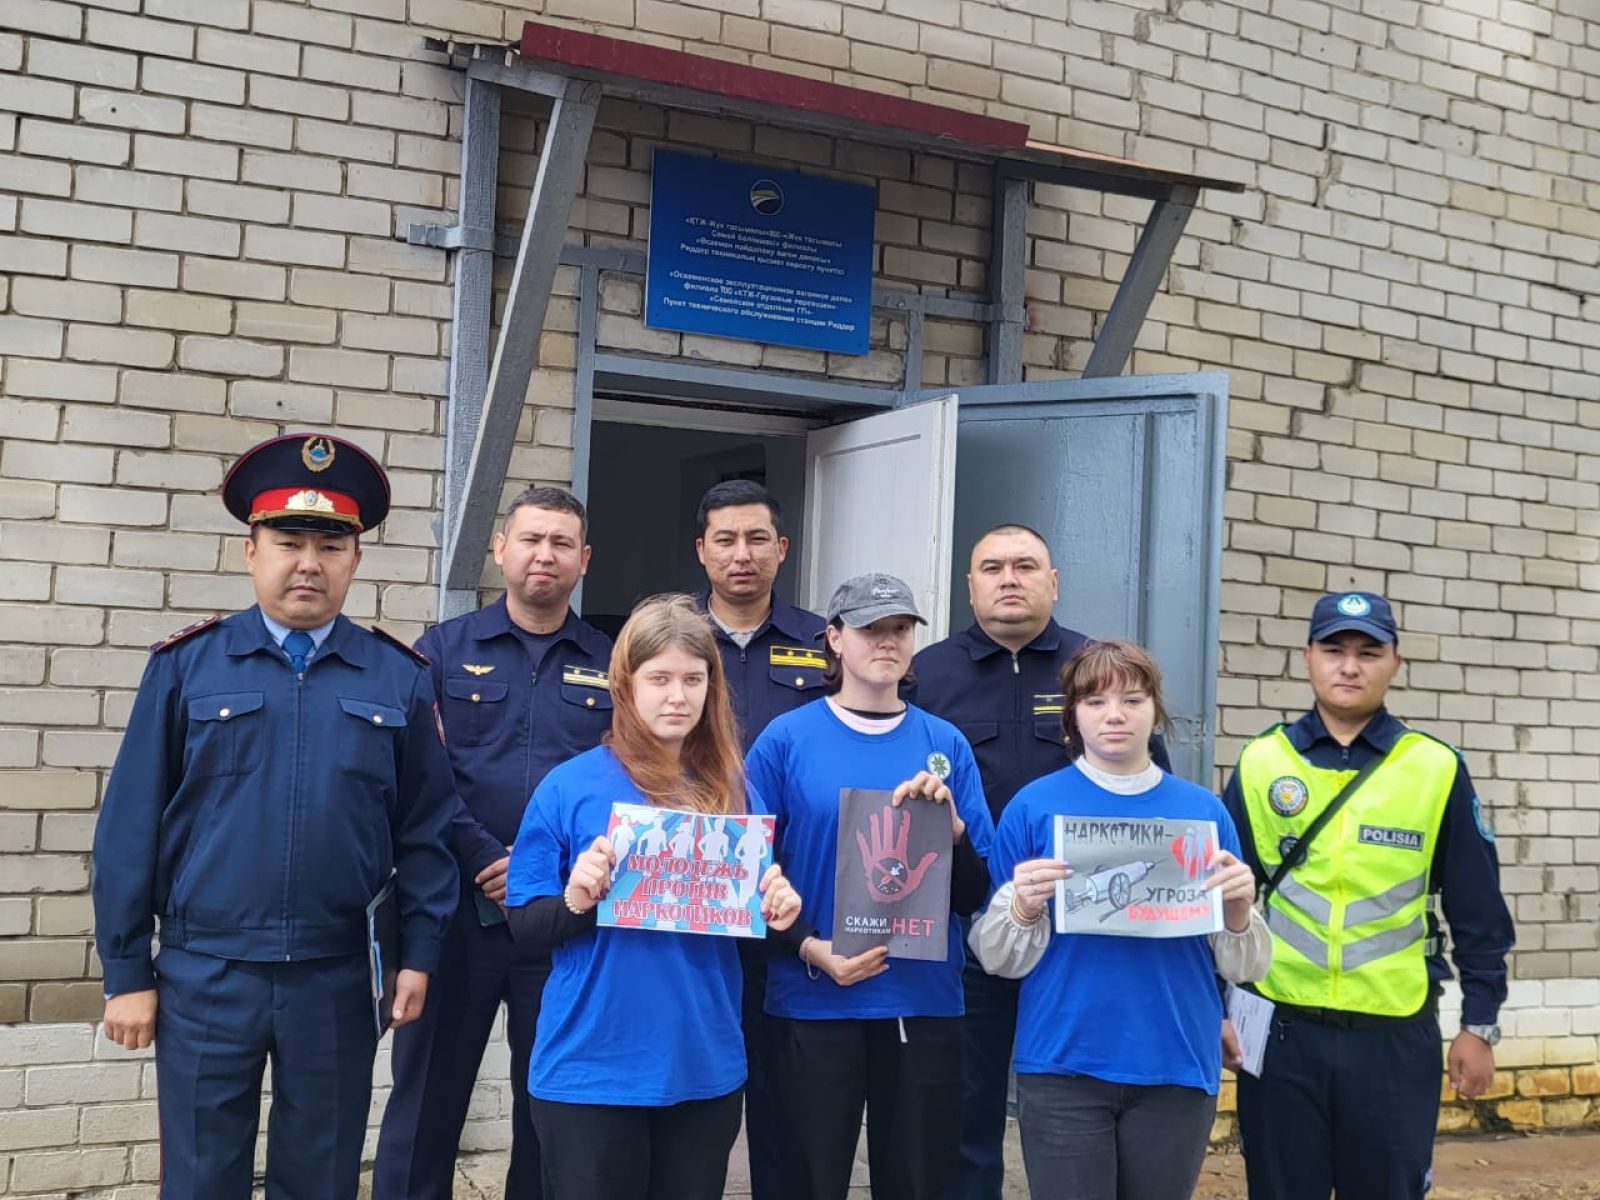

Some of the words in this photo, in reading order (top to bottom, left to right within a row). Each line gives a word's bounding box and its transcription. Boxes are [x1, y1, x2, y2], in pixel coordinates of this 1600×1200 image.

[1361, 828, 1419, 847] POLISIA
[628, 854, 749, 881] МОЛОДЕЖЬ
[641, 878, 728, 901] ПРОТИВ
[1146, 887, 1208, 904] УГРОЗА
[613, 899, 752, 927] НАРКОТИКОВ
[845, 916, 888, 927] СКАЖИ
[844, 926, 892, 936] НАРКОТИКАМ
[892, 917, 936, 937] НЕТ
